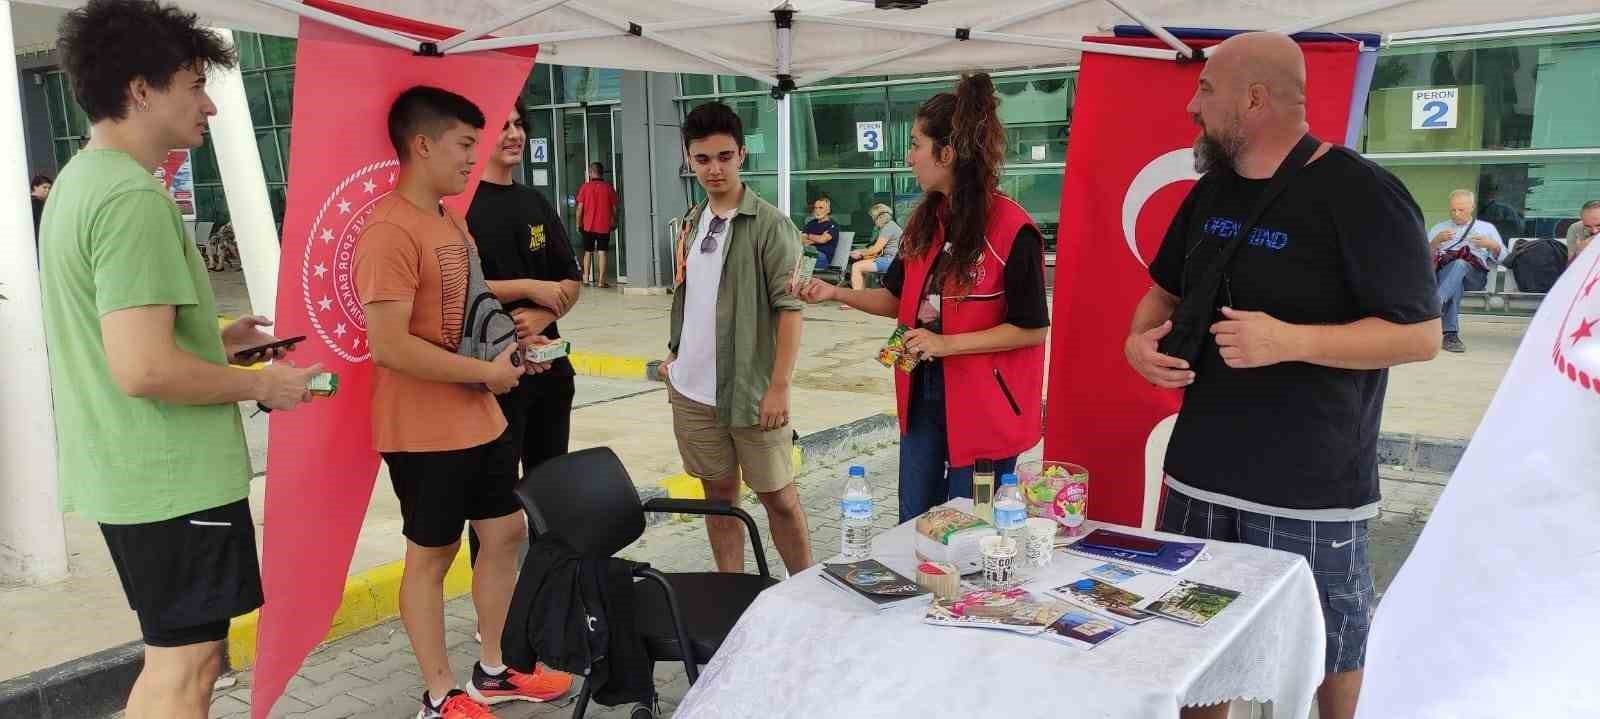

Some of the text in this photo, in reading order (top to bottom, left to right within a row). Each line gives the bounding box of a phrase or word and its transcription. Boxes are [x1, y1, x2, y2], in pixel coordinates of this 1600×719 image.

[1416, 90, 1455, 99] PERON
[1422, 101, 1449, 127] 2
[863, 130, 878, 150] 3
[534, 145, 545, 161] 4
